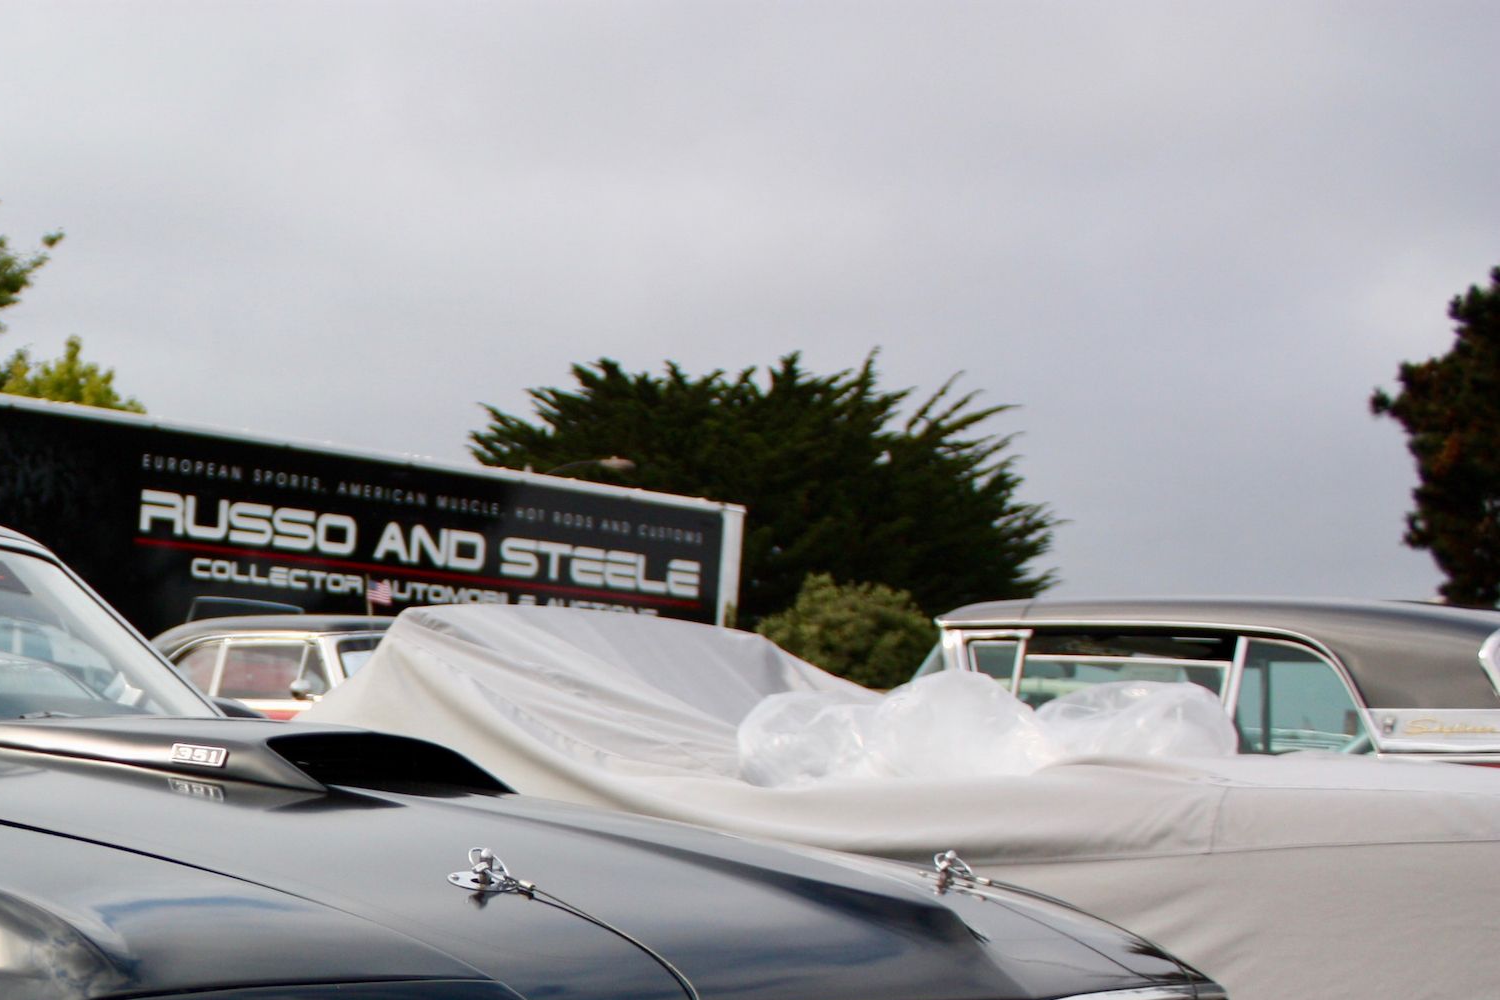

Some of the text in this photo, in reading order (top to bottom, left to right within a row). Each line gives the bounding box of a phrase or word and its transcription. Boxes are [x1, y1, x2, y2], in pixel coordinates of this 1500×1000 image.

[142, 453, 242, 480] EUROPEAN
[338, 481, 428, 506] AMERICAN
[515, 507, 545, 521] HOT
[553, 511, 593, 530] RODS
[602, 519, 631, 534] AND
[638, 523, 704, 544] CUSTOMS
[139, 488, 701, 598] RUSSO AND STEELE
[191, 557, 364, 594] COLLECTOR
[177, 747, 218, 763] 351
